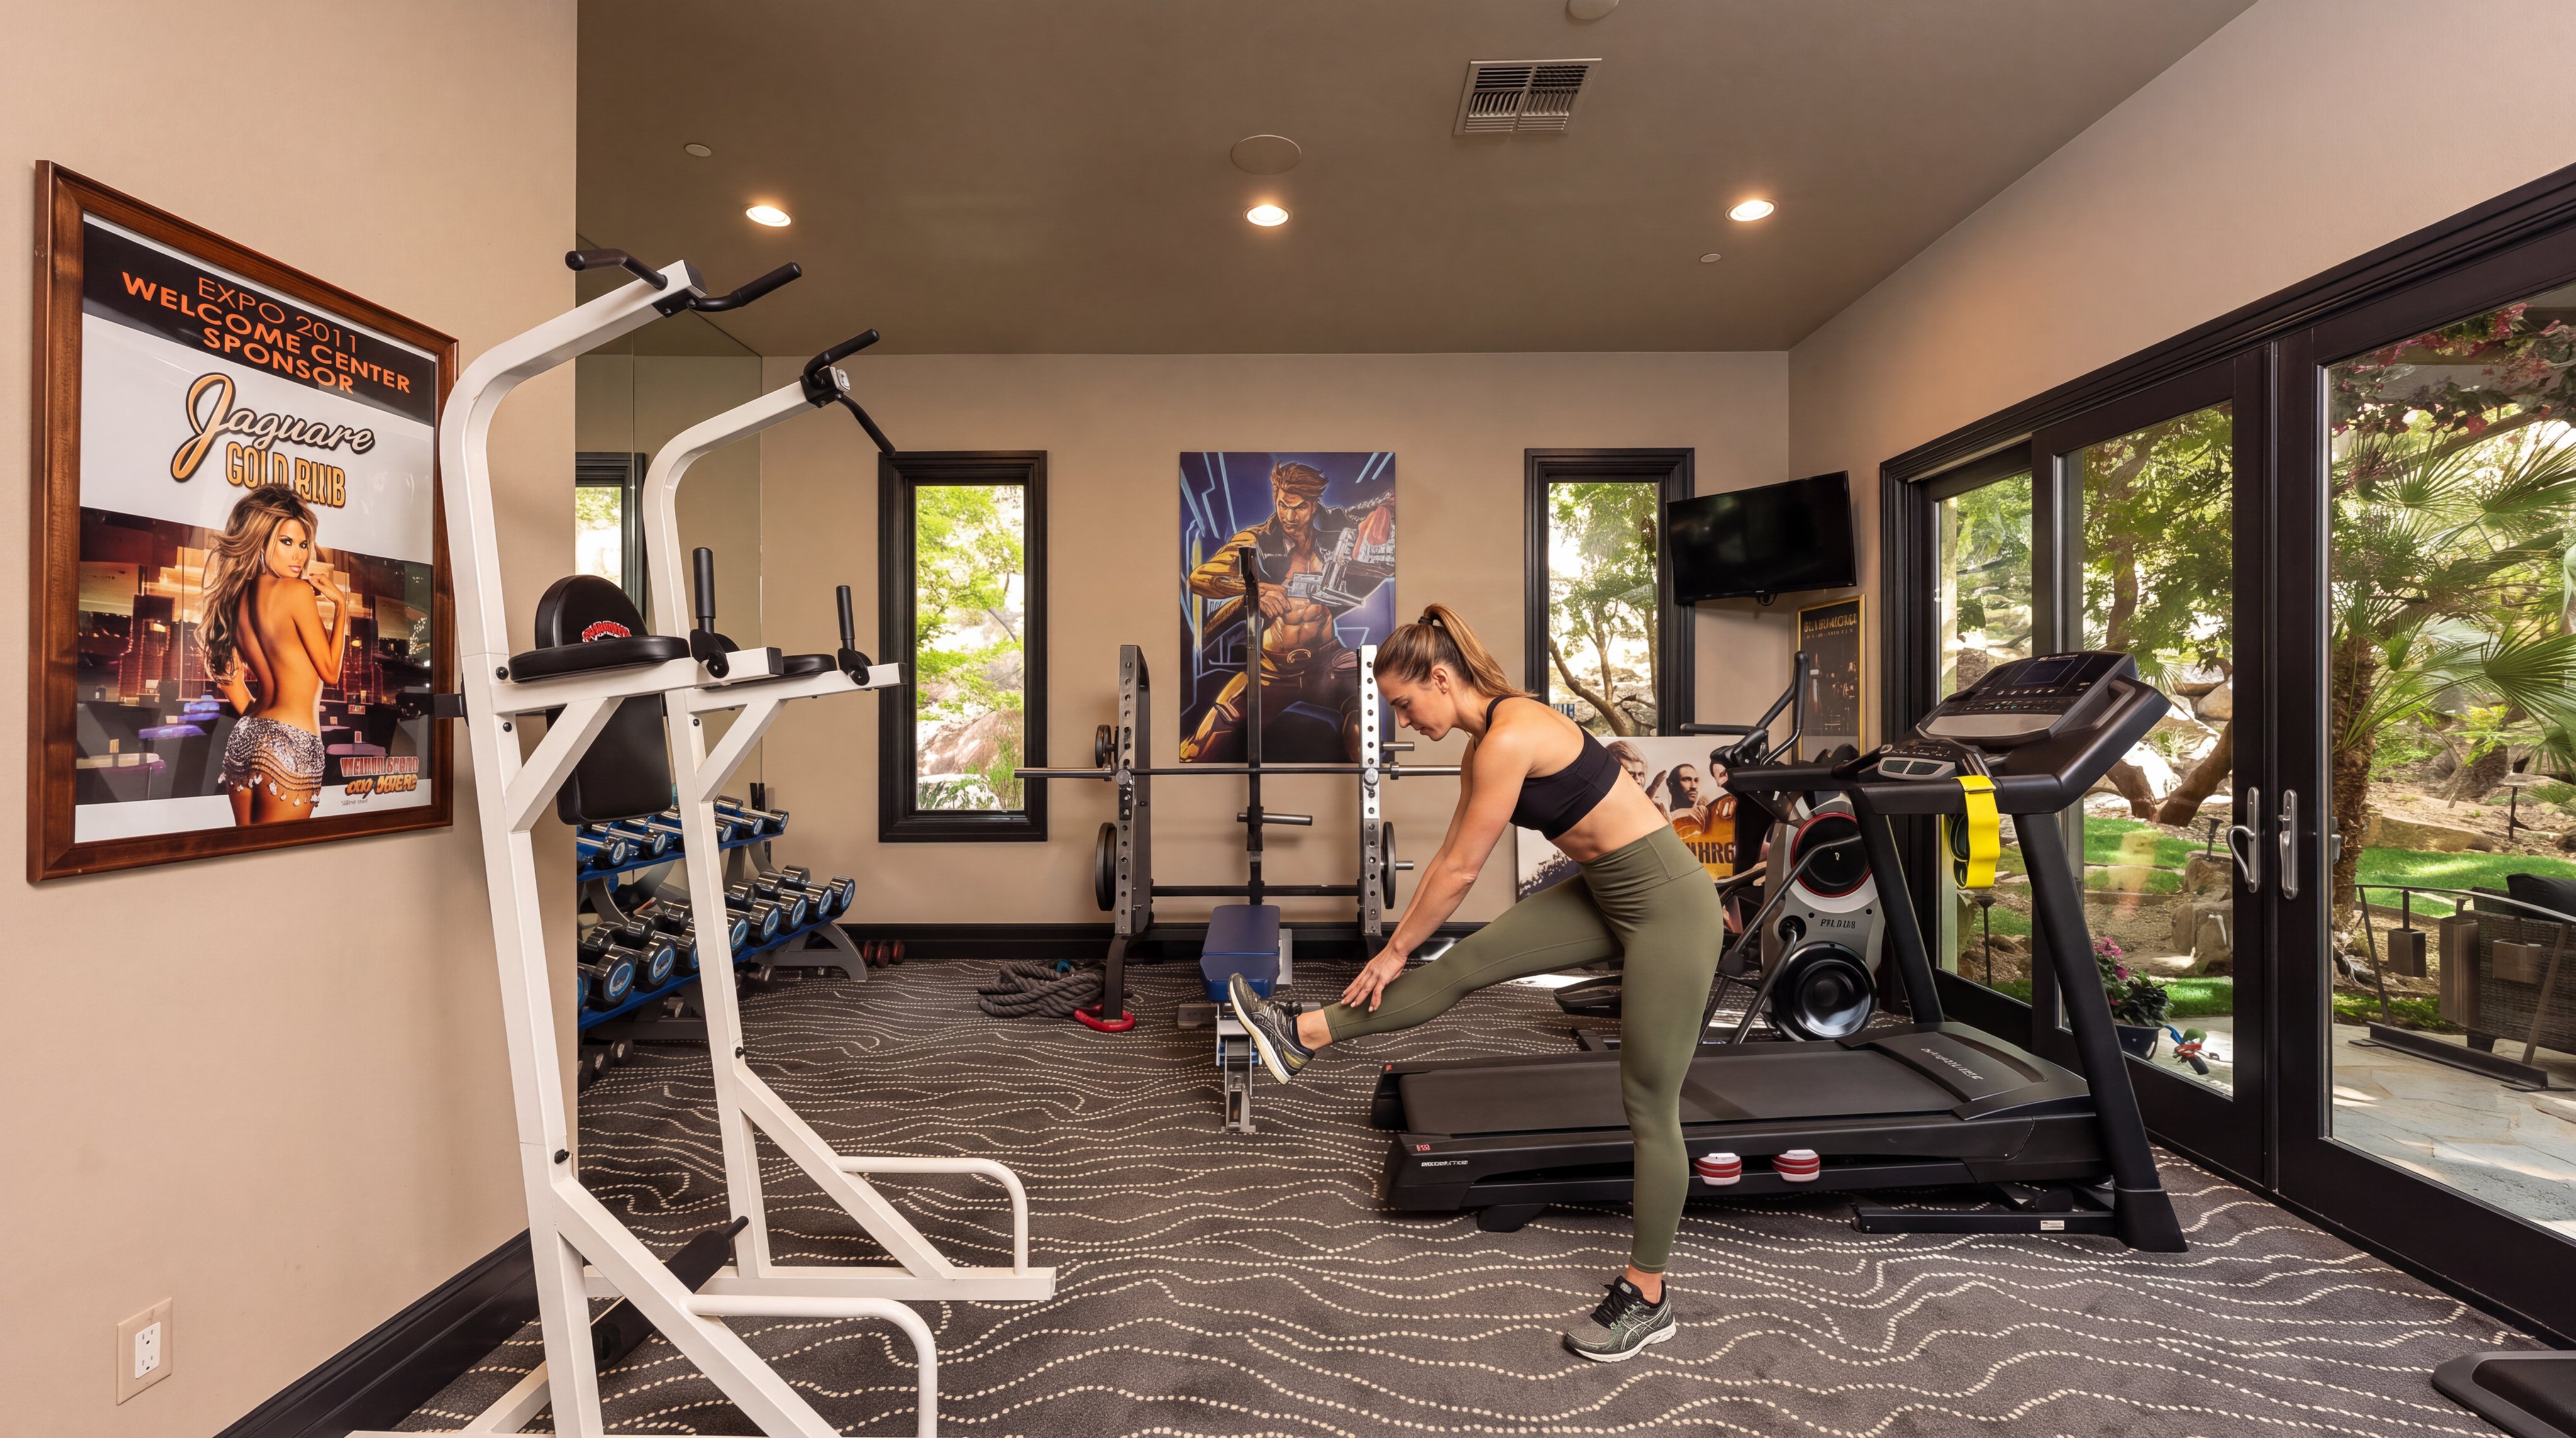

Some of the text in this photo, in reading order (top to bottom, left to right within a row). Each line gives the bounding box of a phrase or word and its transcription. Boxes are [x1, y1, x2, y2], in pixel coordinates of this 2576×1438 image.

[122, 271, 411, 393] WELCOME CENTER
[199, 276, 355, 353] EXPO 2011
[203, 327, 353, 394] SPONSOR
[170, 372, 375, 482] Jaguare
